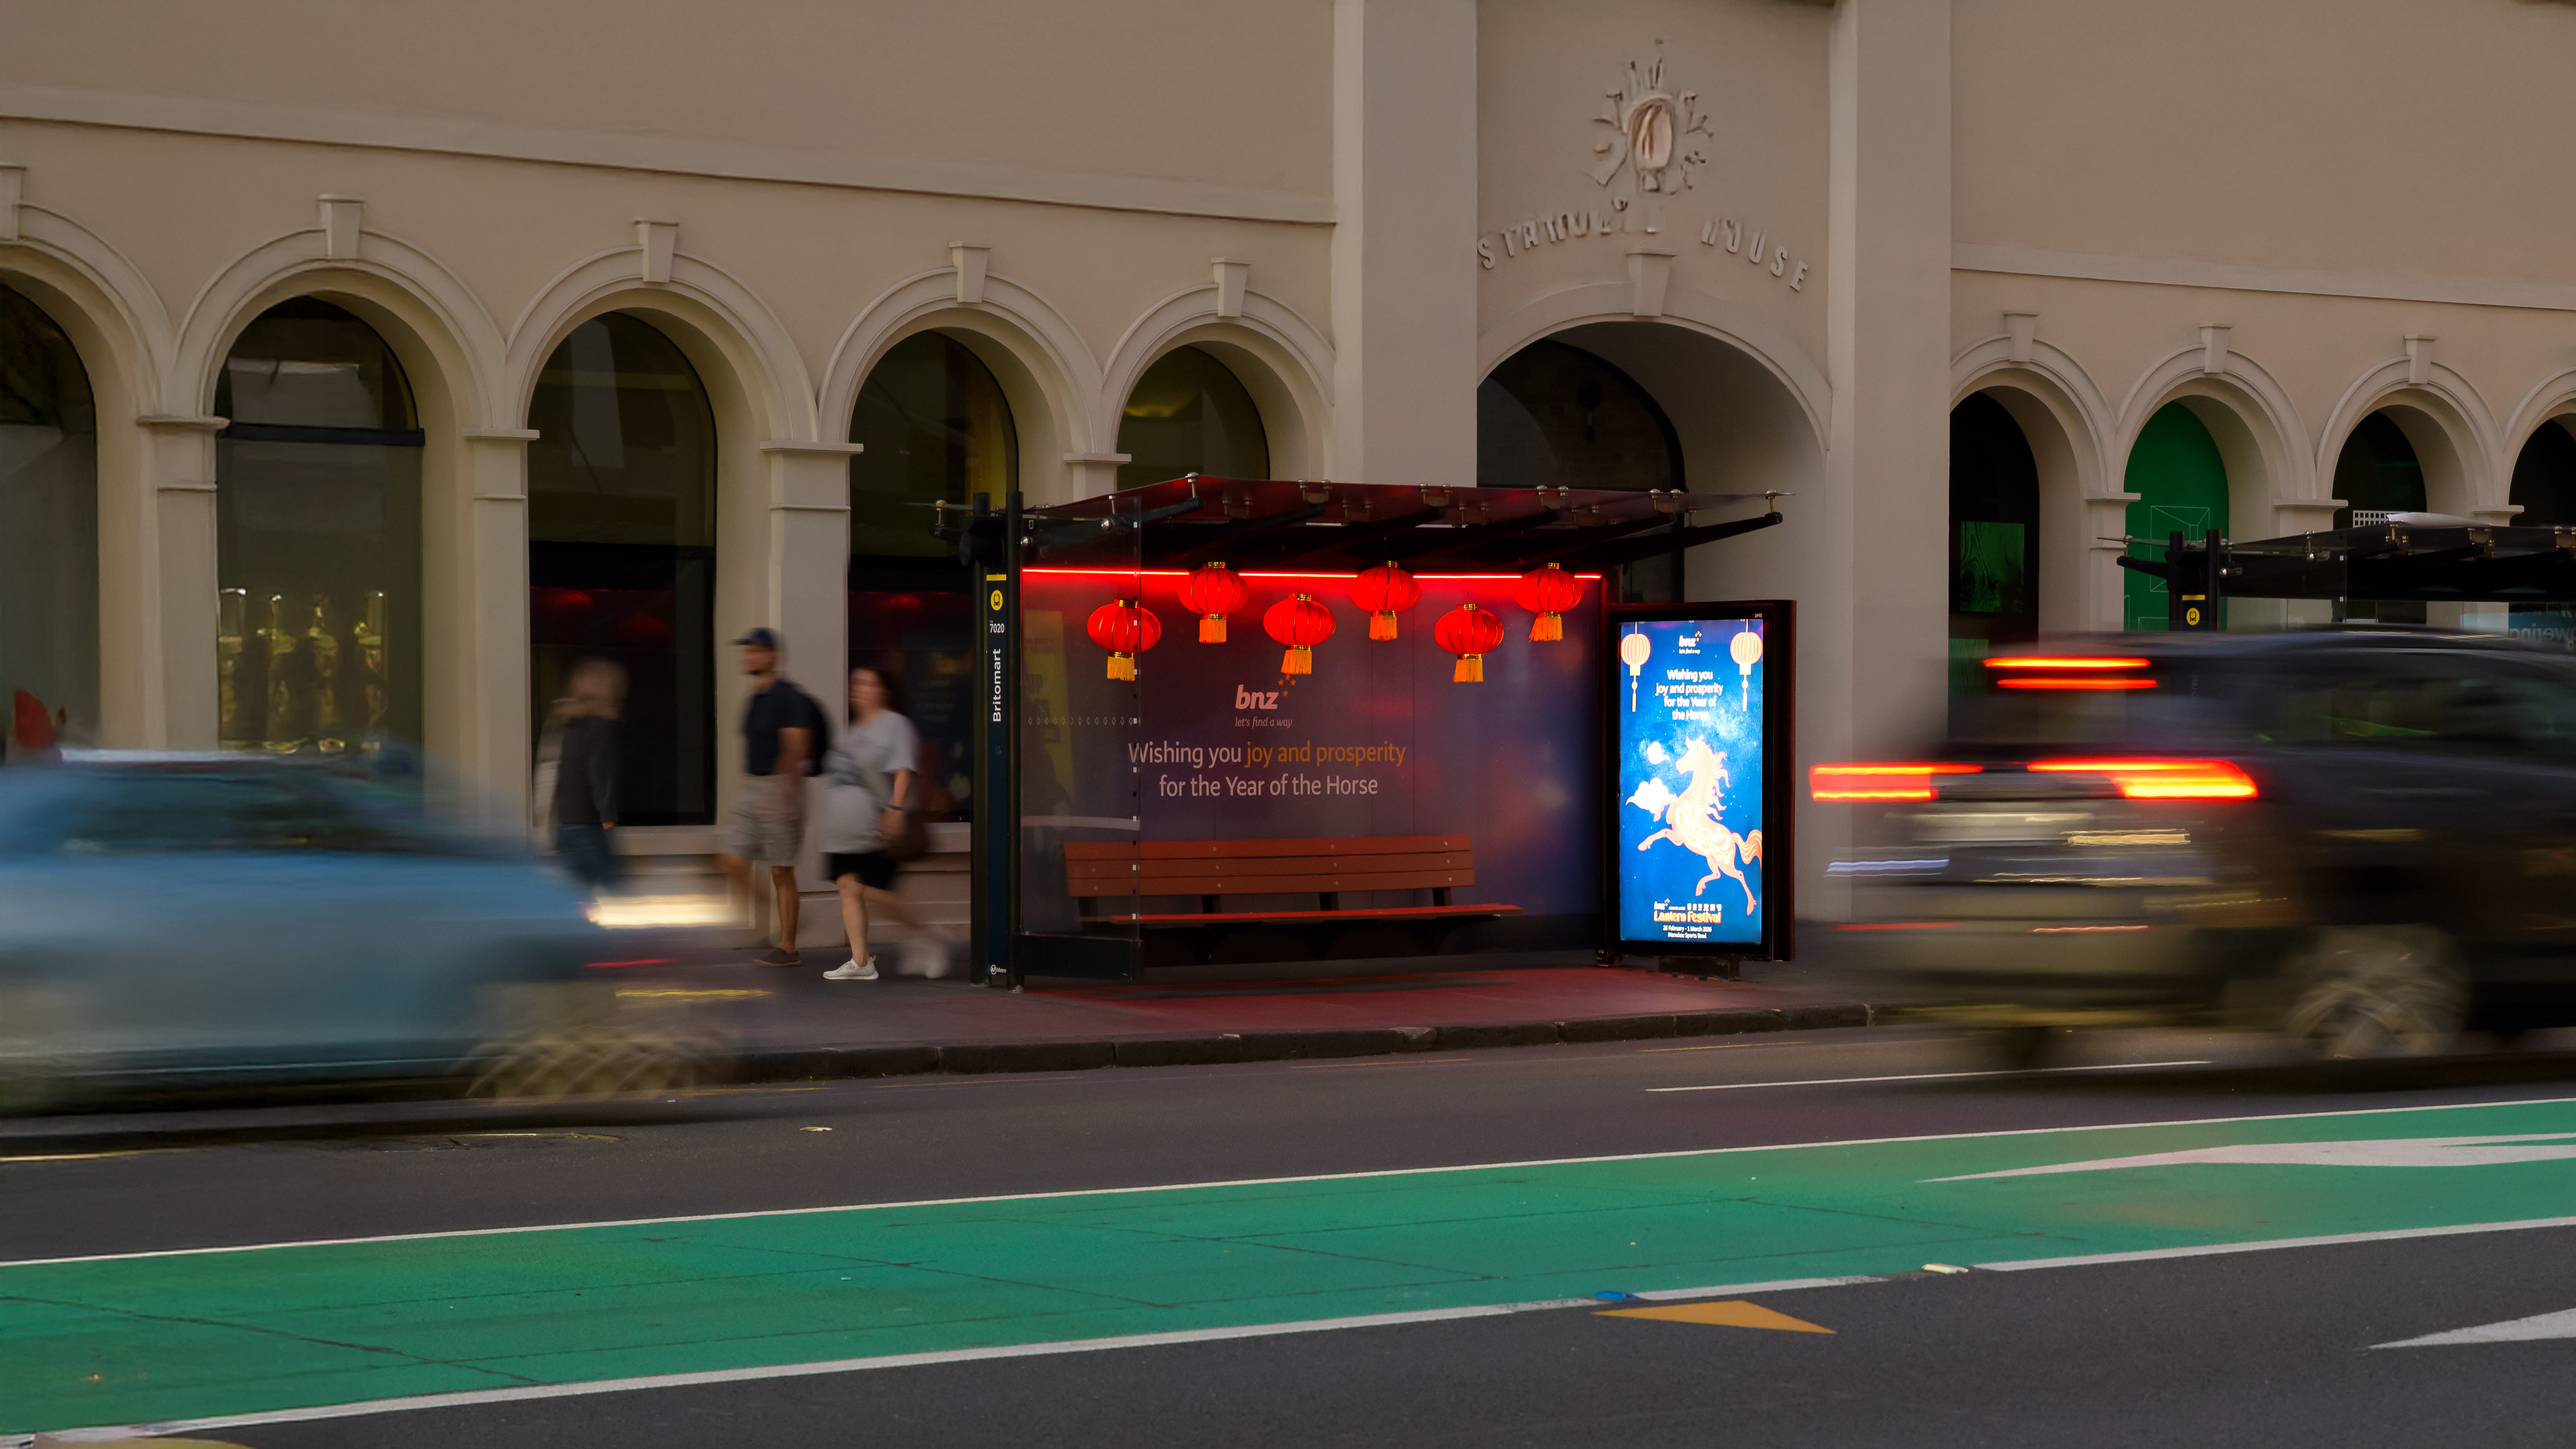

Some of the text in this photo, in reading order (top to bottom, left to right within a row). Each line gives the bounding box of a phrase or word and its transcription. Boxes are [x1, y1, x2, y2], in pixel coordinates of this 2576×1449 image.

[990, 623, 1005, 633] 7020
[1679, 635, 1696, 647] bnz
[1667, 668, 1713, 682] Wishing you
[993, 648, 1001, 722] Britomart
[1655, 682, 1723, 696] joy and prosperity
[1235, 684, 1279, 709] bnz
[1664, 695, 1717, 707] for the Year of
[1672, 709, 1685, 720] the
[1235, 716, 1250, 726] let's
[1252, 716, 1268, 729] find
[1277, 720, 1292, 729] way
[1129, 740, 1406, 768] Wishing you joy and prosperity
[1160, 773, 1378, 796] for the Year of the Horse
[1654, 910, 1722, 924] Lantern Festival
